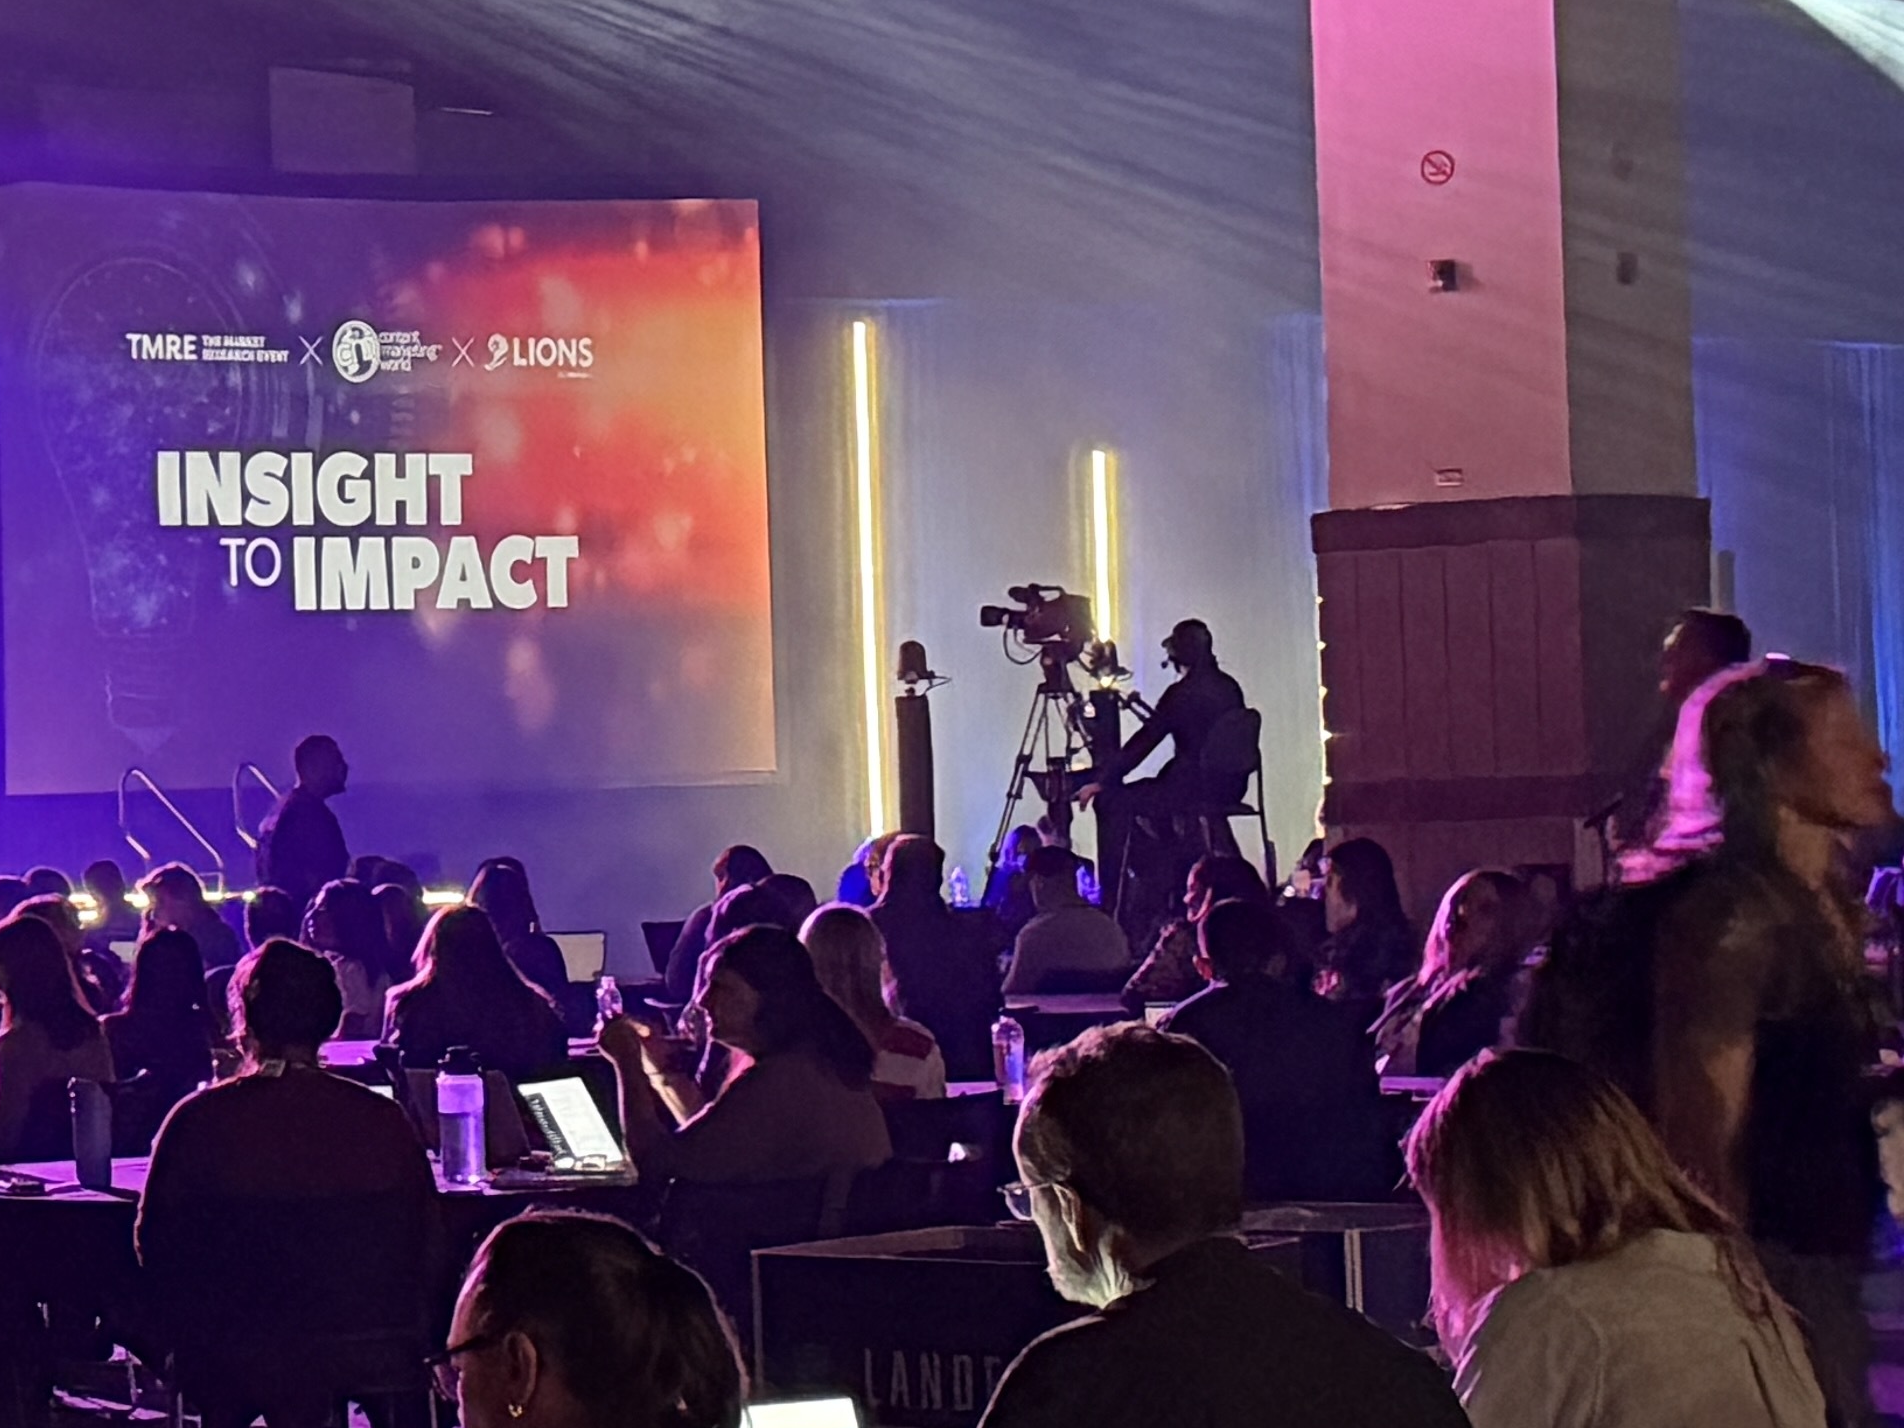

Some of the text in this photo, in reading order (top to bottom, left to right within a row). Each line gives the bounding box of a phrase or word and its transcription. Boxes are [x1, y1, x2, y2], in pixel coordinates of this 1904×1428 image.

[125, 332, 198, 360] TMRE
[512, 336, 593, 368] LIONS
[156, 450, 474, 527] INSIGHT
[219, 534, 580, 611] TO IMPACT
